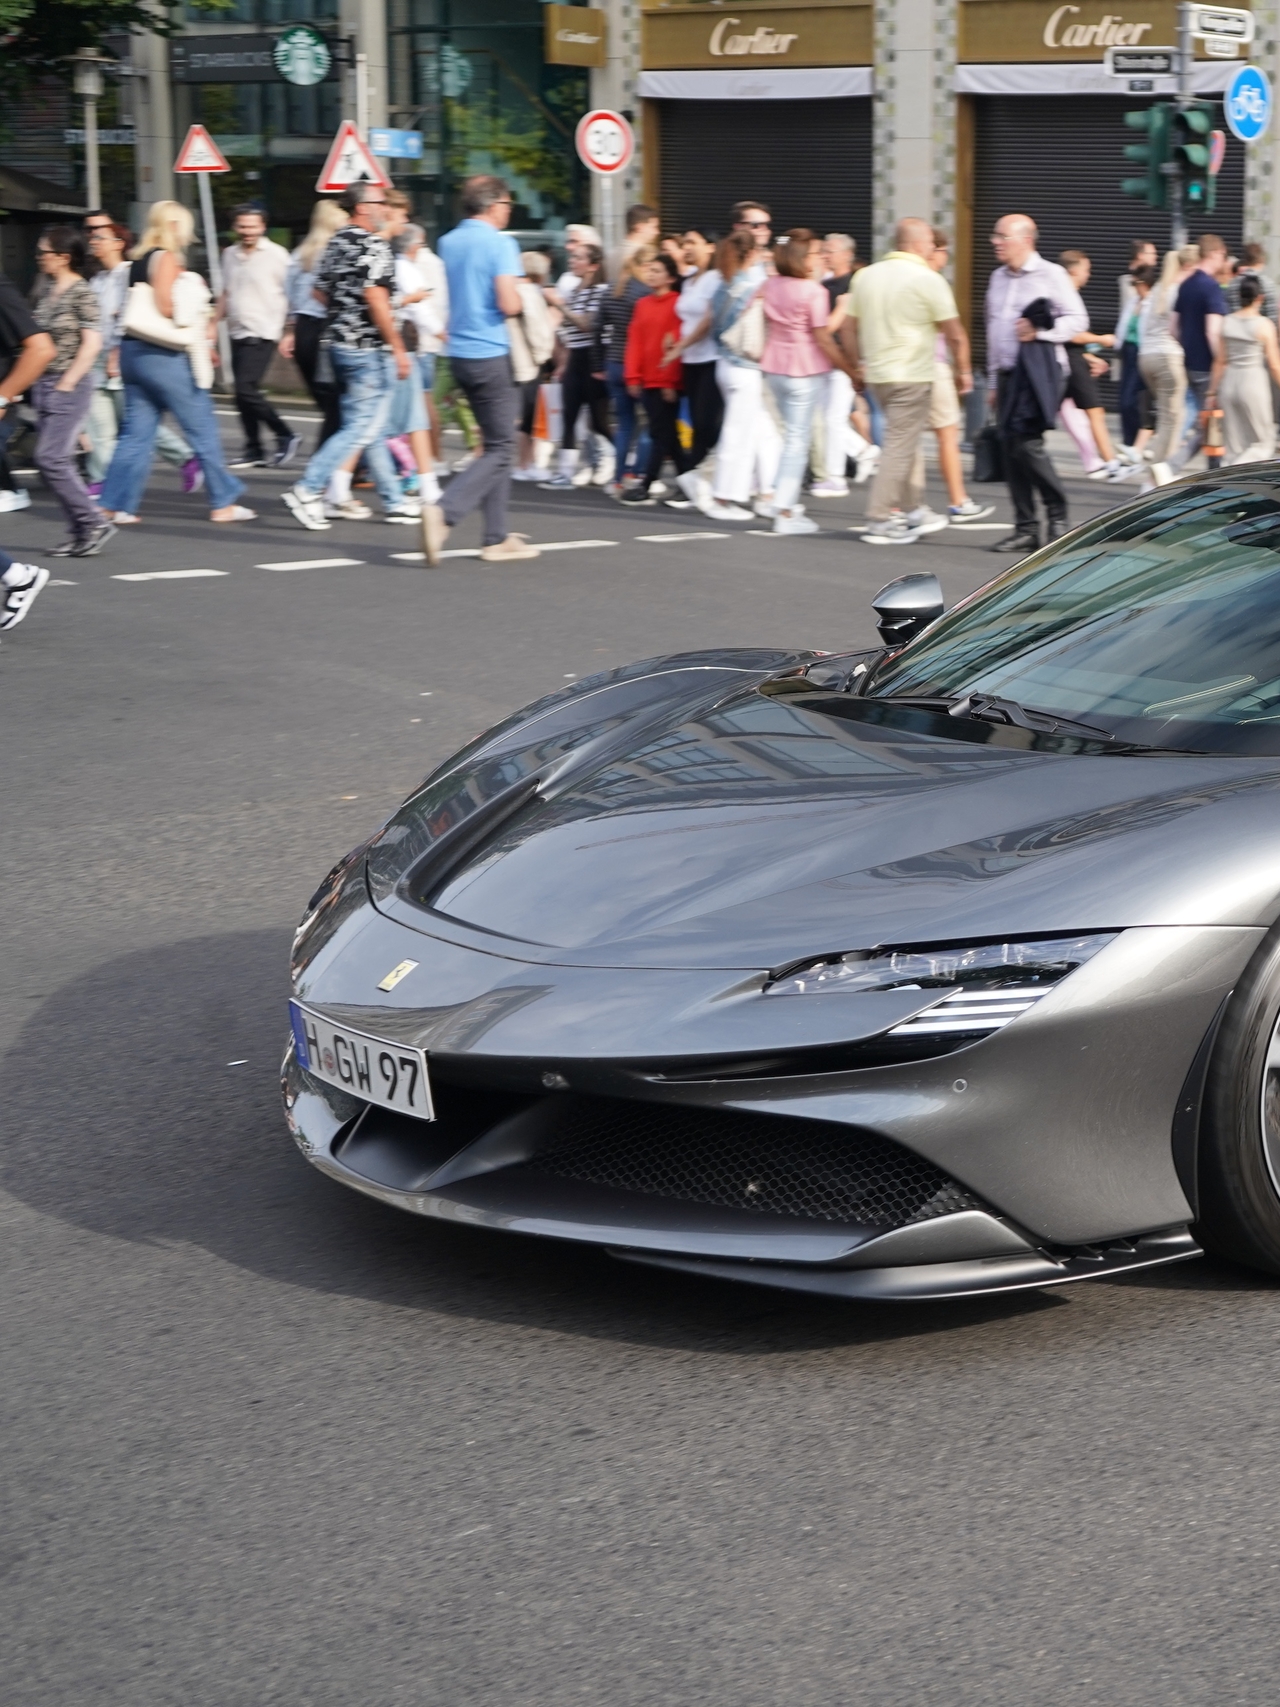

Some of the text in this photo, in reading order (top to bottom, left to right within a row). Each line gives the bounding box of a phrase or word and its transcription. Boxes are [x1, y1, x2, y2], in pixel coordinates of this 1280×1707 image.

[708, 17, 798, 55] Cartier
[1043, 4, 1152, 47] Cartier
[591, 129, 621, 157] 30
[302, 1016, 419, 1107] H GW 97
